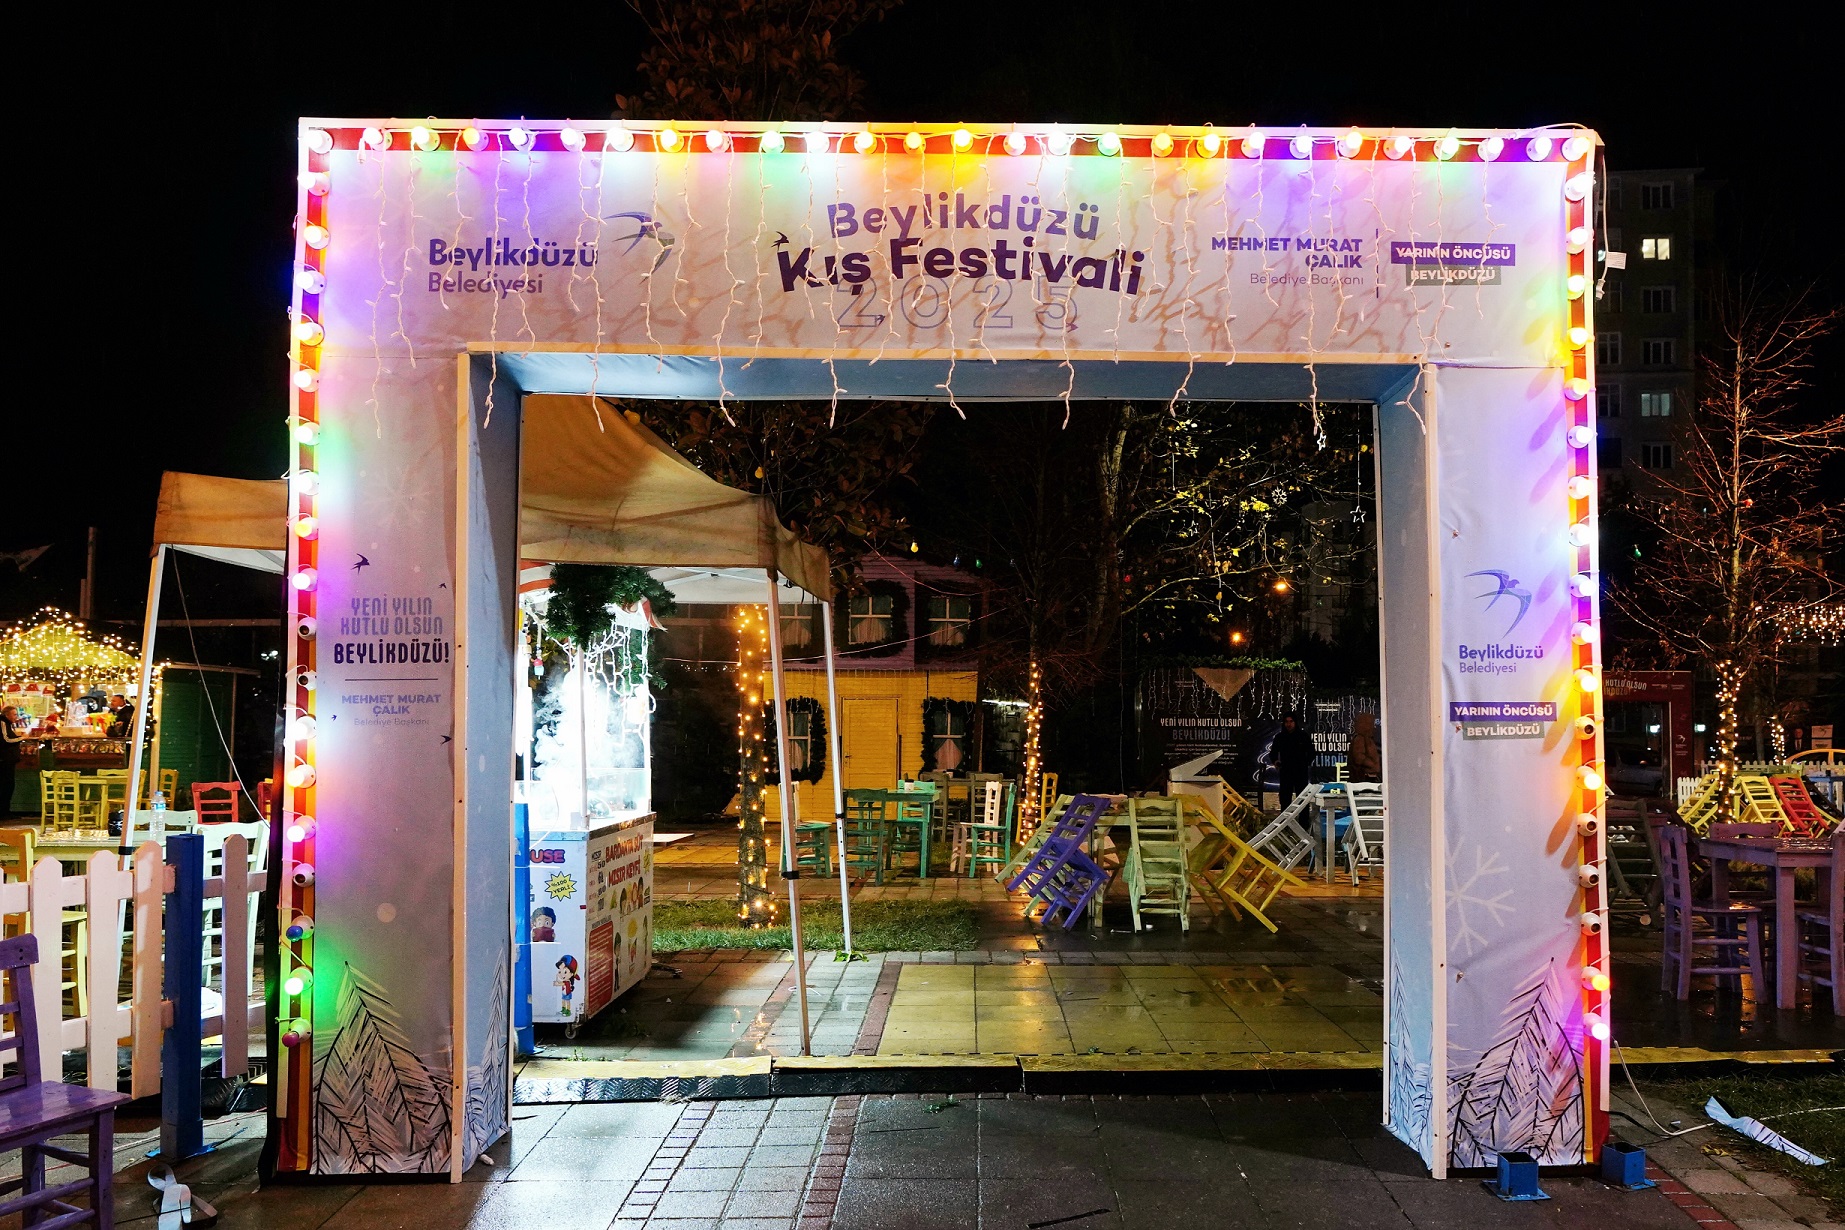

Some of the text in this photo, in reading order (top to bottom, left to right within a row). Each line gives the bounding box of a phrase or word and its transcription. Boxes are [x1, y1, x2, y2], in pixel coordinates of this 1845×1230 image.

[827, 191, 1100, 241] Beylikdüzü
[1211, 236, 1363, 252] MEHMET MURAT
[428, 237, 599, 271] Beylikdüzü
[1396, 245, 1511, 260] YARININ ÖNCÜSÜ
[778, 236, 1146, 295] Kış Festivali
[1305, 254, 1363, 271] ÇALIK
[1250, 273, 1364, 287] Belediye Başkanı
[1410, 266, 1496, 281] BEYLİKDÜZÜ
[428, 271, 543, 299] Belediyesi
[836, 273, 1078, 329] 2025
[351, 593, 432, 616] YENİ YILIN
[341, 616, 443, 635] KUTLU OLSUN
[333, 638, 450, 664] BEYLİKDÜZÜ!
[1459, 643, 1544, 662] Beylikdüzü
[1459, 662, 1517, 675] Belediyesi
[341, 694, 441, 704] MEHMET MURAT
[372, 705, 410, 717] ÇALIK
[1454, 704, 1553, 716] YARININ ÖNCÜSÜ
[354, 717, 392, 727] Belediye
[1160, 716, 1176, 727] YENİ
[1178, 718, 1196, 727] YILIN
[1467, 723, 1540, 737] BEYLİKDÜZÜ
[1313, 742, 1327, 752] TLU
